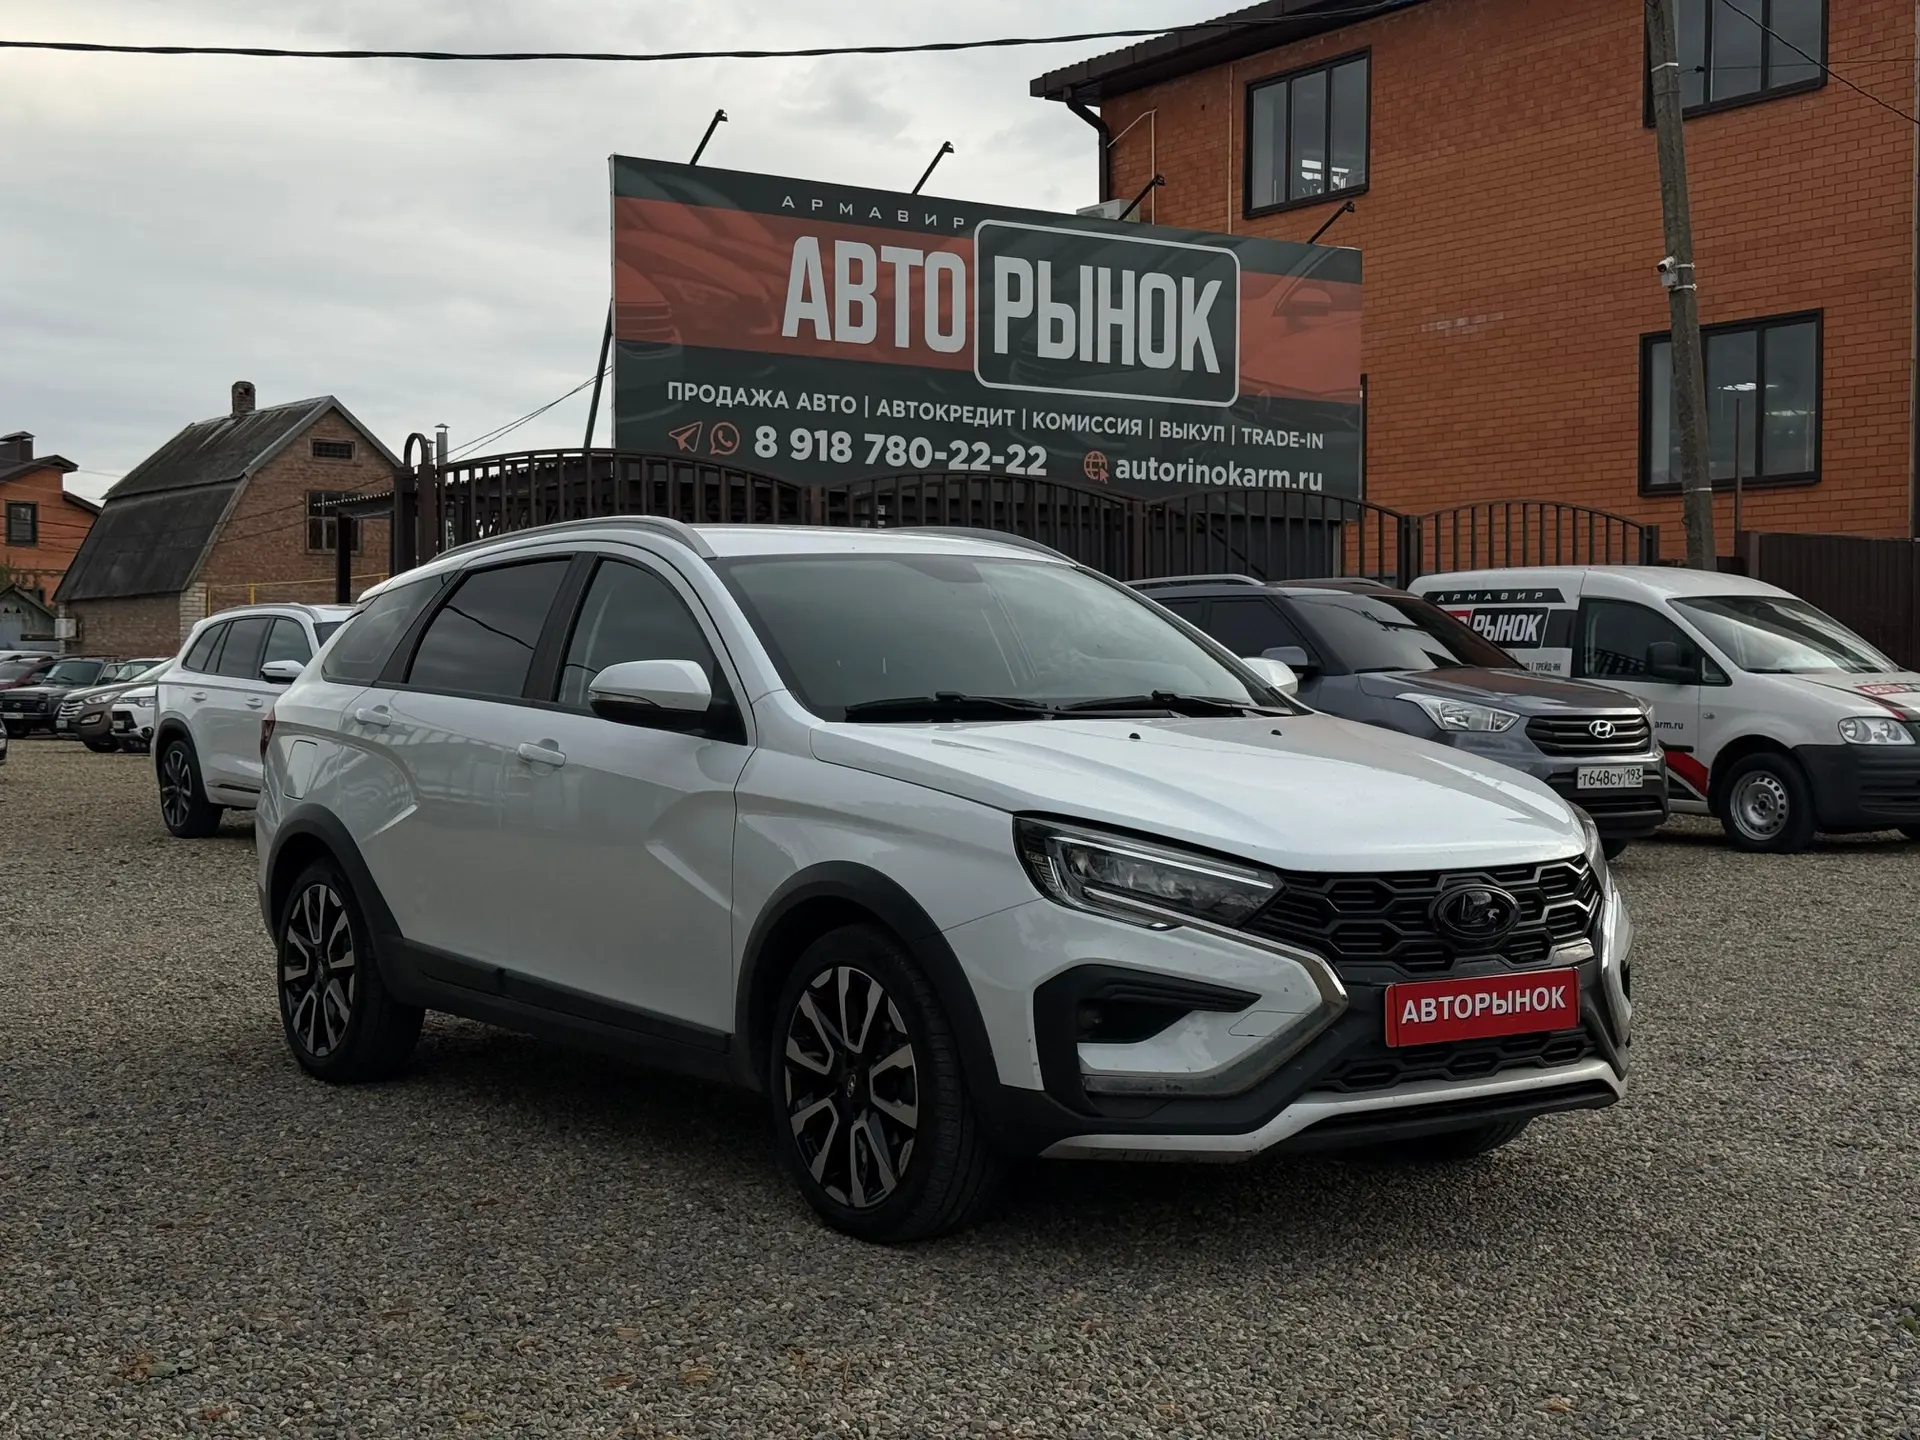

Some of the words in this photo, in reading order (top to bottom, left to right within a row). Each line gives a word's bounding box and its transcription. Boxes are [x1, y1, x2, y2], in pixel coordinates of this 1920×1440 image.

[782, 195, 966, 229] АРМАВИР
[781, 235, 967, 354] АВТО
[993, 255, 1223, 374] РЫНОК
[667, 381, 790, 410] ПРОДАЖА
[796, 392, 857, 415] АВТО
[876, 399, 1016, 428] АВТОКРЕДИТ
[1031, 411, 1142, 436] КОМИССИЯ
[1159, 420, 1226, 443] ВЫКУП
[1241, 427, 1324, 450] TRADE-IN
[754, 425, 778, 459] 8
[790, 427, 853, 464] 918
[864, 433, 1048, 477] 780-22-22
[1115, 457, 1323, 492] autorinokarm.ru
[1437, 592, 1544, 602] АРМАВИР
[1401, 985, 1566, 1024] АВТОРЫНОК
